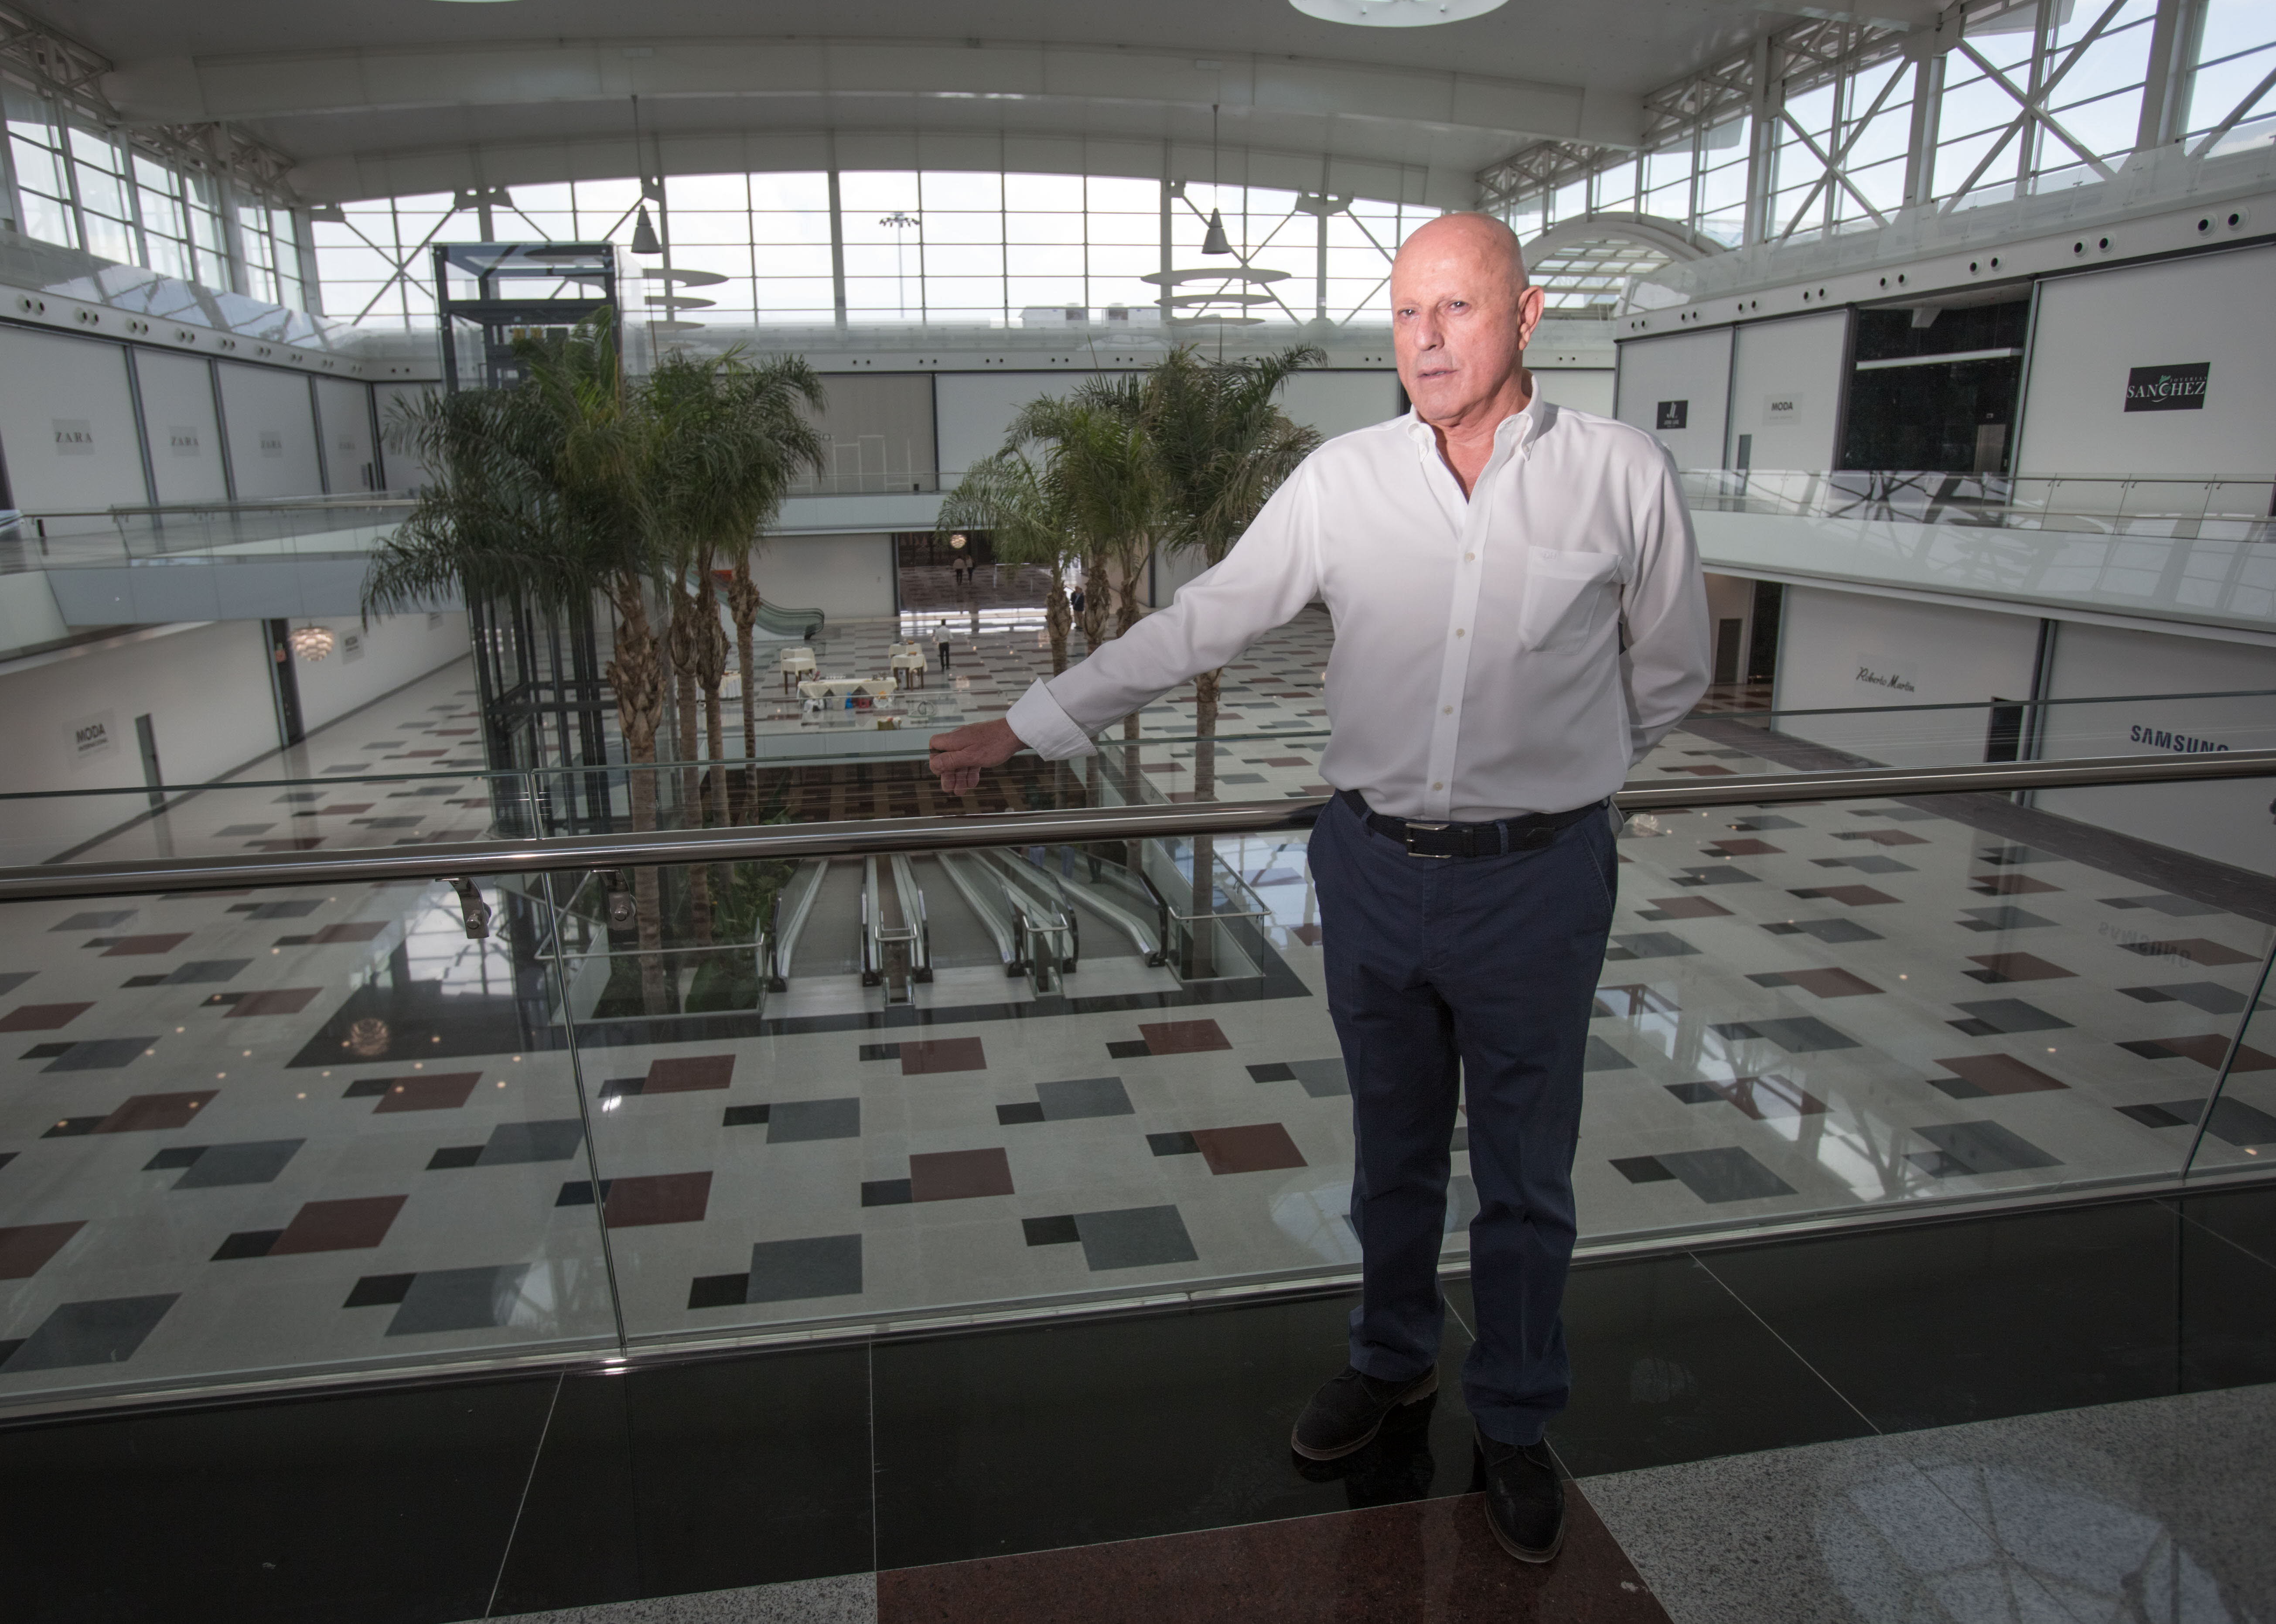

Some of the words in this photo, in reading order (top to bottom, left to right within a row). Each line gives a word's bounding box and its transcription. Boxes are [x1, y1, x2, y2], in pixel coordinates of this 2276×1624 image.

[2126, 381, 2206, 398] SANCHEZ
[1771, 402, 1793, 411] MODA
[55, 431, 94, 443] ZARA
[171, 436, 199, 446] ZARA
[76, 723, 106, 743] MODA
